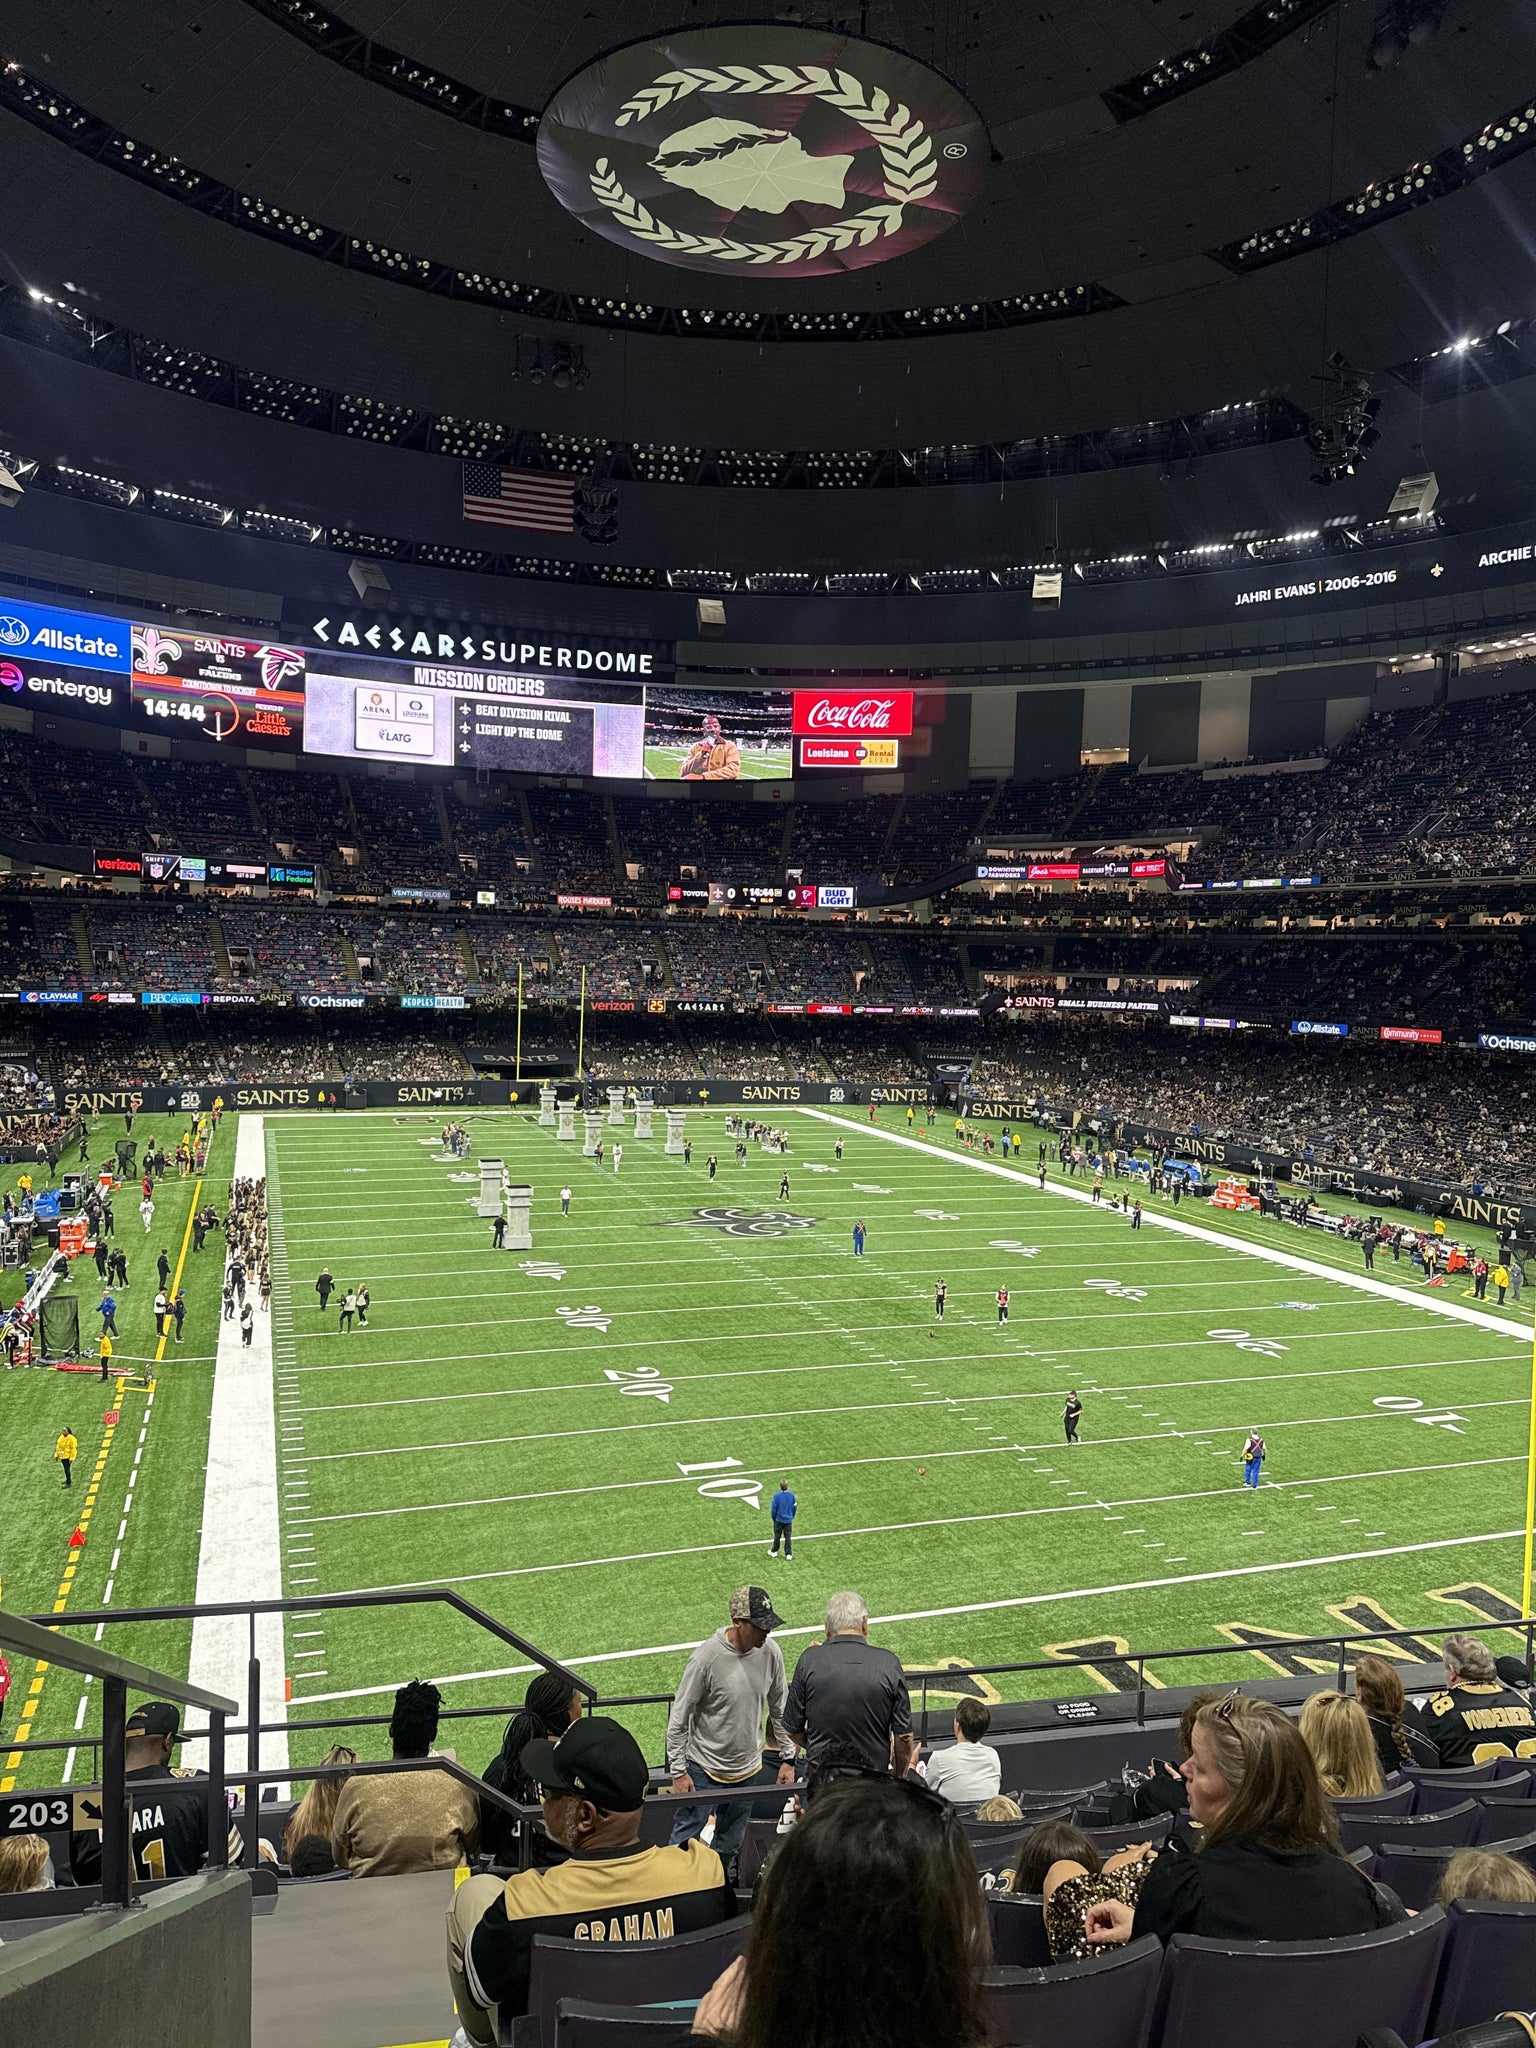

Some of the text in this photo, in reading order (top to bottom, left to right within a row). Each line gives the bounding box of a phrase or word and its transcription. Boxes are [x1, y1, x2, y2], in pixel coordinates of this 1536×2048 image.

[1478, 546, 1532, 568] ARCHIE
[1235, 570, 1397, 606] JAHRI EVANS 2006-2016
[32, 628, 118, 658] Allstate
[194, 639, 245, 658] SAINTS
[312, 617, 653, 674] CAESARS SUPERDOME
[199, 668, 242, 681] FALCONS
[182, 678, 221, 692] COUNTDOWN
[414, 666, 545, 696] MISSION ORDERS
[28, 677, 112, 705] entergy
[143, 698, 206, 721] 14:44
[363, 705, 391, 715] ARENA
[475, 704, 571, 723] BEAT DIVISION RIVAL
[808, 699, 896, 728] Coca-Cola
[255, 711, 286, 726] Little
[246, 719, 292, 736] Caesars
[475, 723, 563, 741] LIGHT UP THE DOME
[386, 732, 412, 743] LATG
[807, 748, 850, 758] Louisiana
[97, 858, 141, 871] verizon
[285, 868, 313, 877] Keesler
[1387, 871, 1417, 881] SAINTS
[1450, 869, 1482, 878] SAINTS
[285, 875, 313, 884] Federal
[1327, 875, 1355, 883] SAINTS
[355, 885, 384, 893] SAINTS
[392, 889, 423, 897] VENTURE
[727, 888, 736, 899] 0
[749, 888, 775, 897] 14:44
[788, 889, 797, 900] 0
[825, 889, 846, 897] BUD
[522, 893, 548, 901] SAINTS
[636, 898, 661, 906] SAINTS
[821, 897, 851, 905] LIGHT
[1393, 905, 1422, 914] SAINTS
[1457, 904, 1488, 913] SAINTS
[39, 992, 78, 1000] CLAYMAR
[150, 993, 171, 1003] BBC
[213, 995, 256, 1003] REPDATA
[259, 993, 292, 1002] SAINTS
[308, 995, 365, 1008] Ochsner
[402, 997, 464, 1007] PEOPLES HEALTH
[475, 997, 504, 1005] SAINTS
[1015, 996, 1055, 1008] SAINTS
[590, 1000, 635, 1011] verizon
[649, 1000, 664, 1011] 25
[677, 1002, 725, 1011] CAESARS
[1058, 1000, 1086, 1008] SMALL
[1086, 1001, 1126, 1009] BUSINESS
[1310, 1024, 1342, 1034] Allstate
[1351, 1026, 1380, 1034] SAINTS
[1383, 1027, 1419, 1041] Community
[1487, 1036, 1536, 1051] Ochsne
[483, 1054, 560, 1062] SAINTS
[236, 1089, 310, 1105] SAINTS
[742, 1086, 801, 1100] SAINTS
[870, 1088, 927, 1102] SAINTS
[64, 1091, 143, 1109] SAINTS
[180, 1093, 201, 1107] 20
[972, 1103, 1034, 1119] SAINTS
[1174, 1136, 1225, 1161] SAINTS
[518, 1260, 567, 1277] 40
[555, 1305, 612, 1327] 30
[1206, 1329, 1291, 1352] 20
[603, 1366, 674, 1396] 20
[1372, 1396, 1471, 1426] 10
[106, 1412, 118, 1423] 20
[675, 1456, 763, 1498] 10
[1067, 1711, 1097, 1719] PLEASE
[8, 1801, 69, 1829] 203
[574, 1907, 675, 1941] GRAHAM
